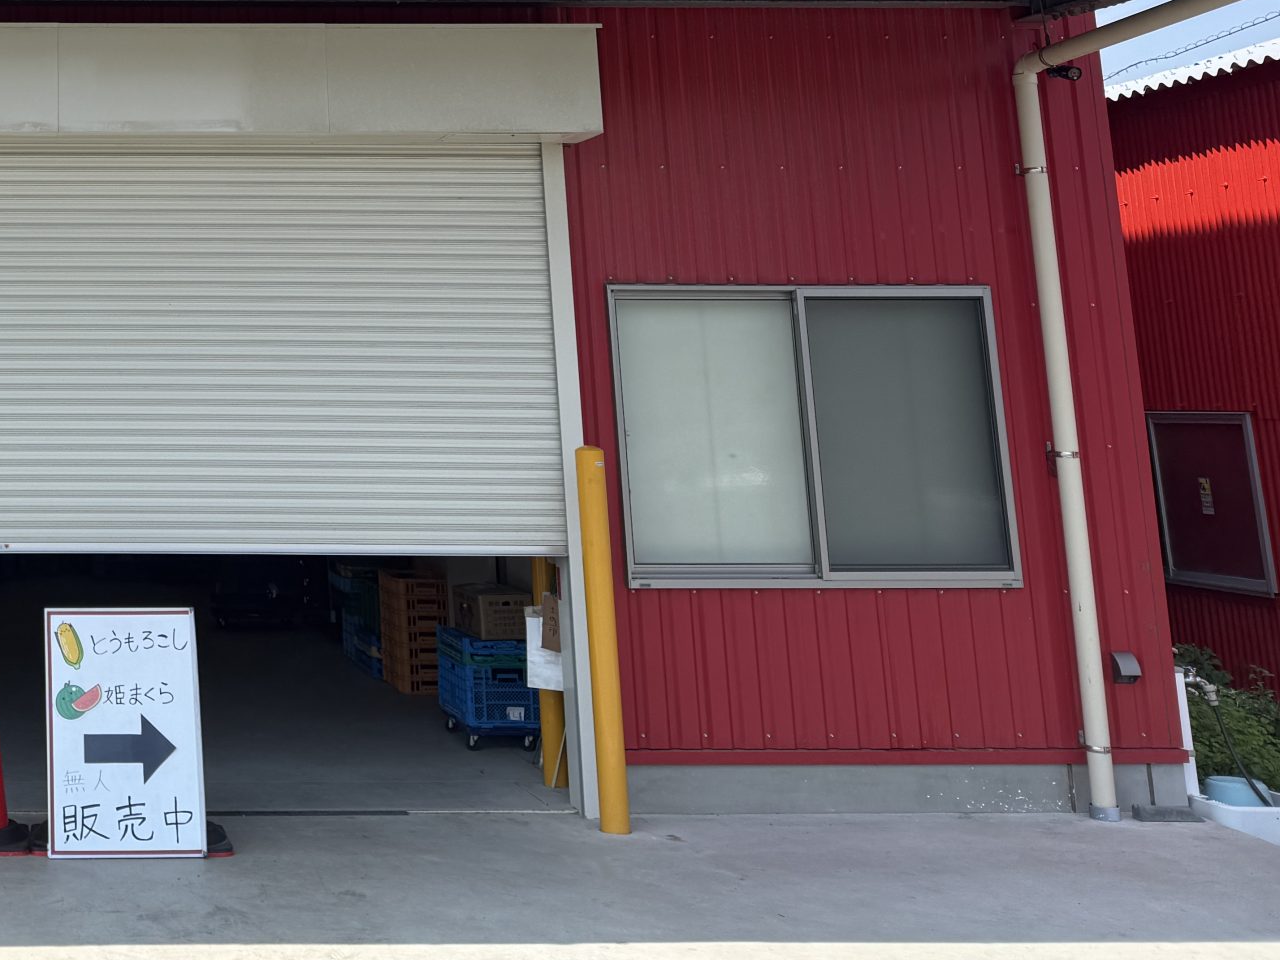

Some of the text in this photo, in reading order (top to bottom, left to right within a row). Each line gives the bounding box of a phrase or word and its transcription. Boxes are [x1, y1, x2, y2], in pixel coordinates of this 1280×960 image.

[90, 627, 189, 656] とうもろこし
[102, 682, 175, 706] 姫まくら
[62, 795, 194, 845] 販売中
